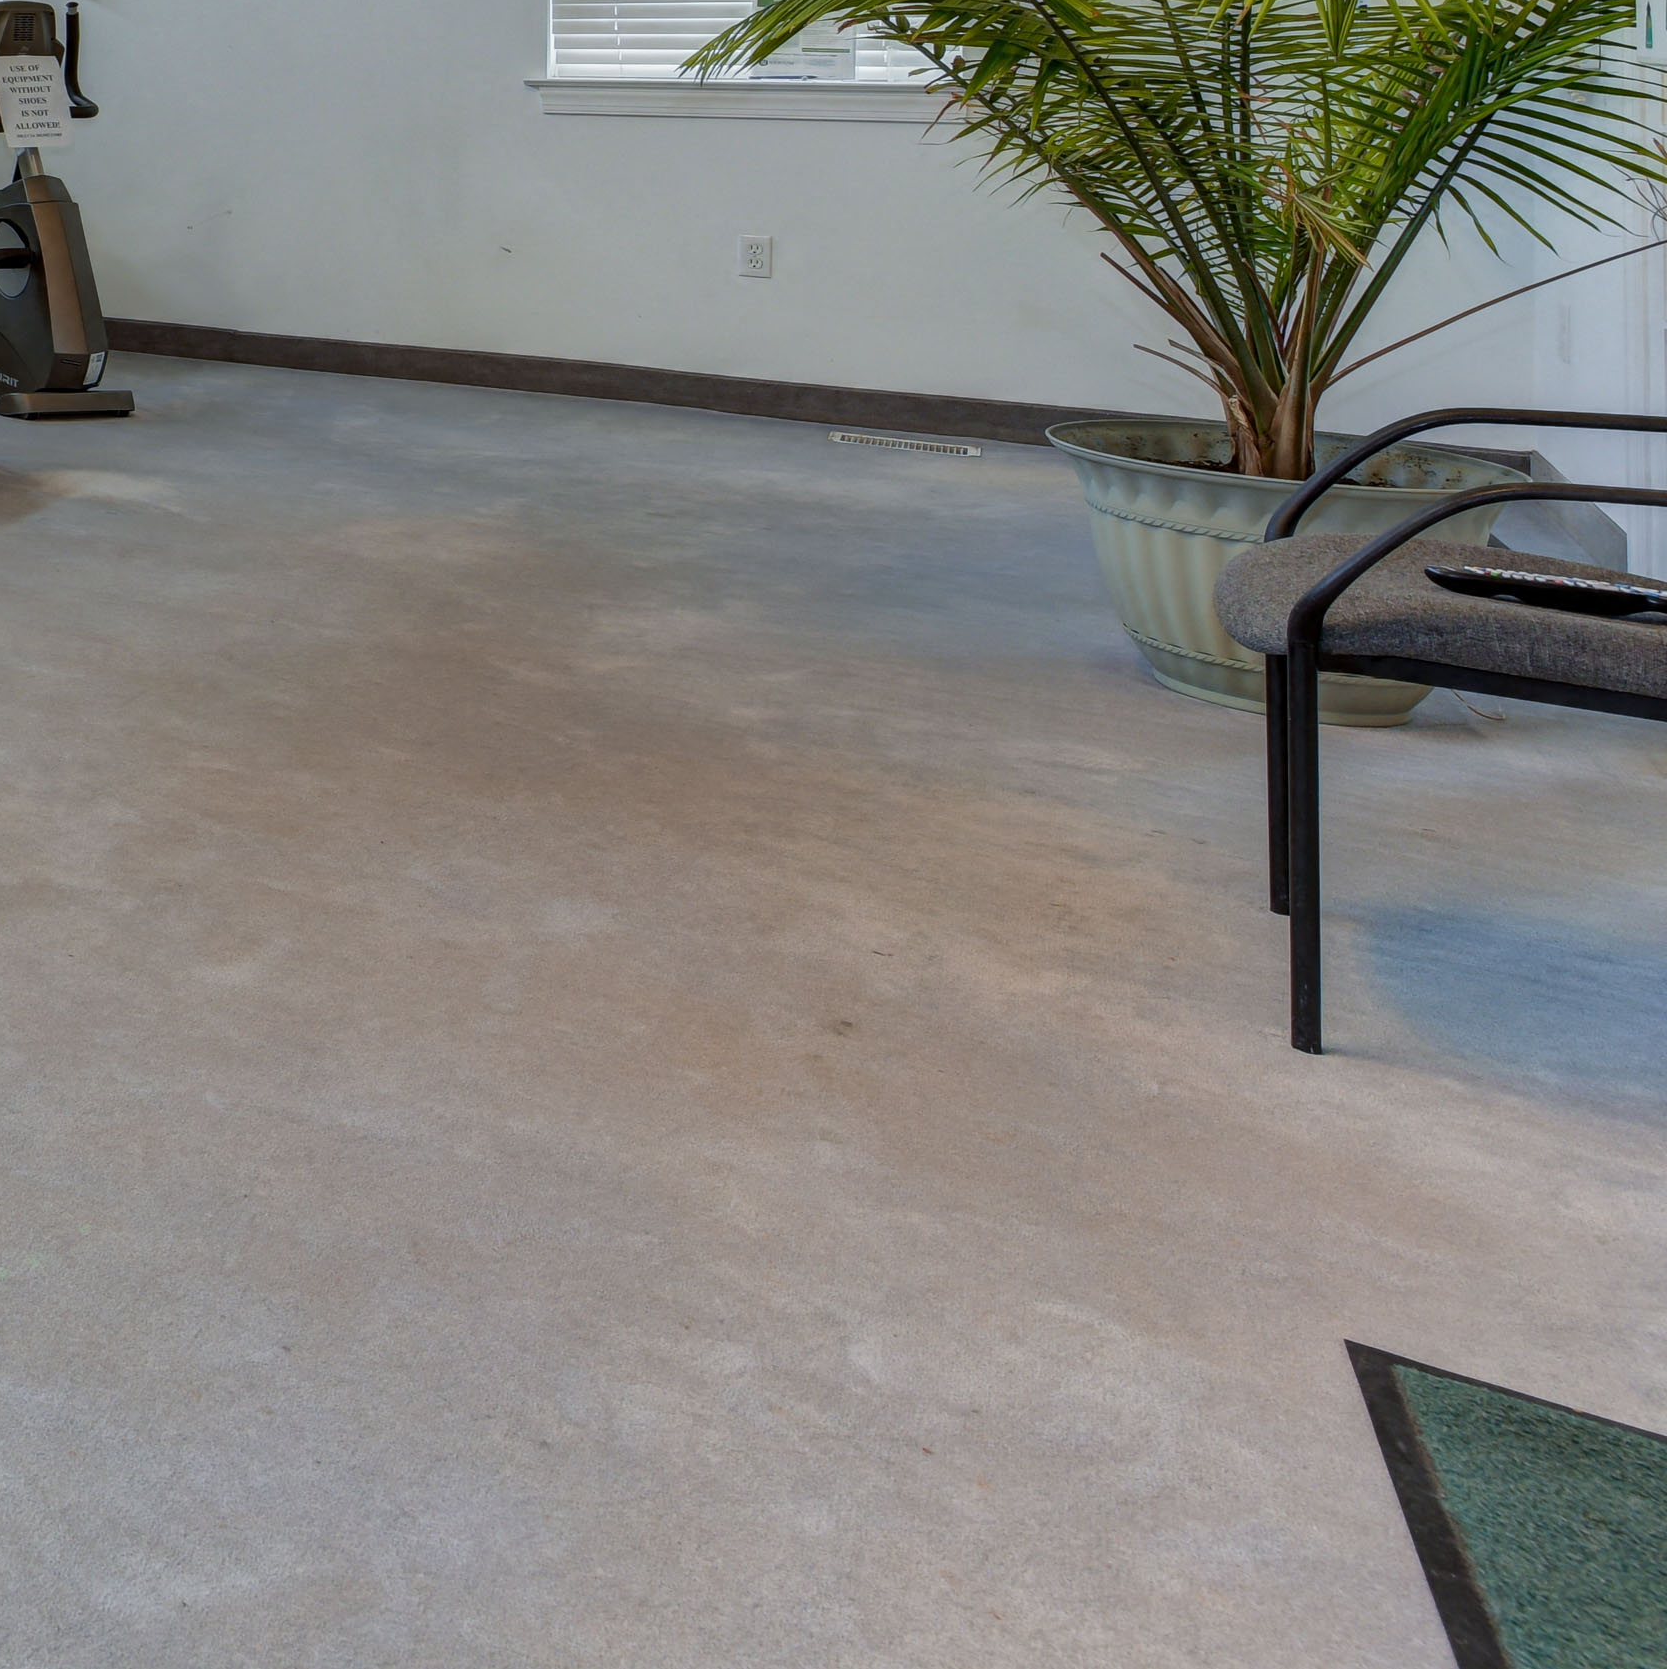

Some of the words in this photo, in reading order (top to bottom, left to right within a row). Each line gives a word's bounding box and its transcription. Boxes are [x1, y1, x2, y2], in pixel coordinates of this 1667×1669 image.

[2, 75, 54, 84] EQUIPMENT
[18, 97, 47, 105] SHOES
[31, 109, 49, 117] NOT
[15, 122, 61, 130] ALLOWED!
